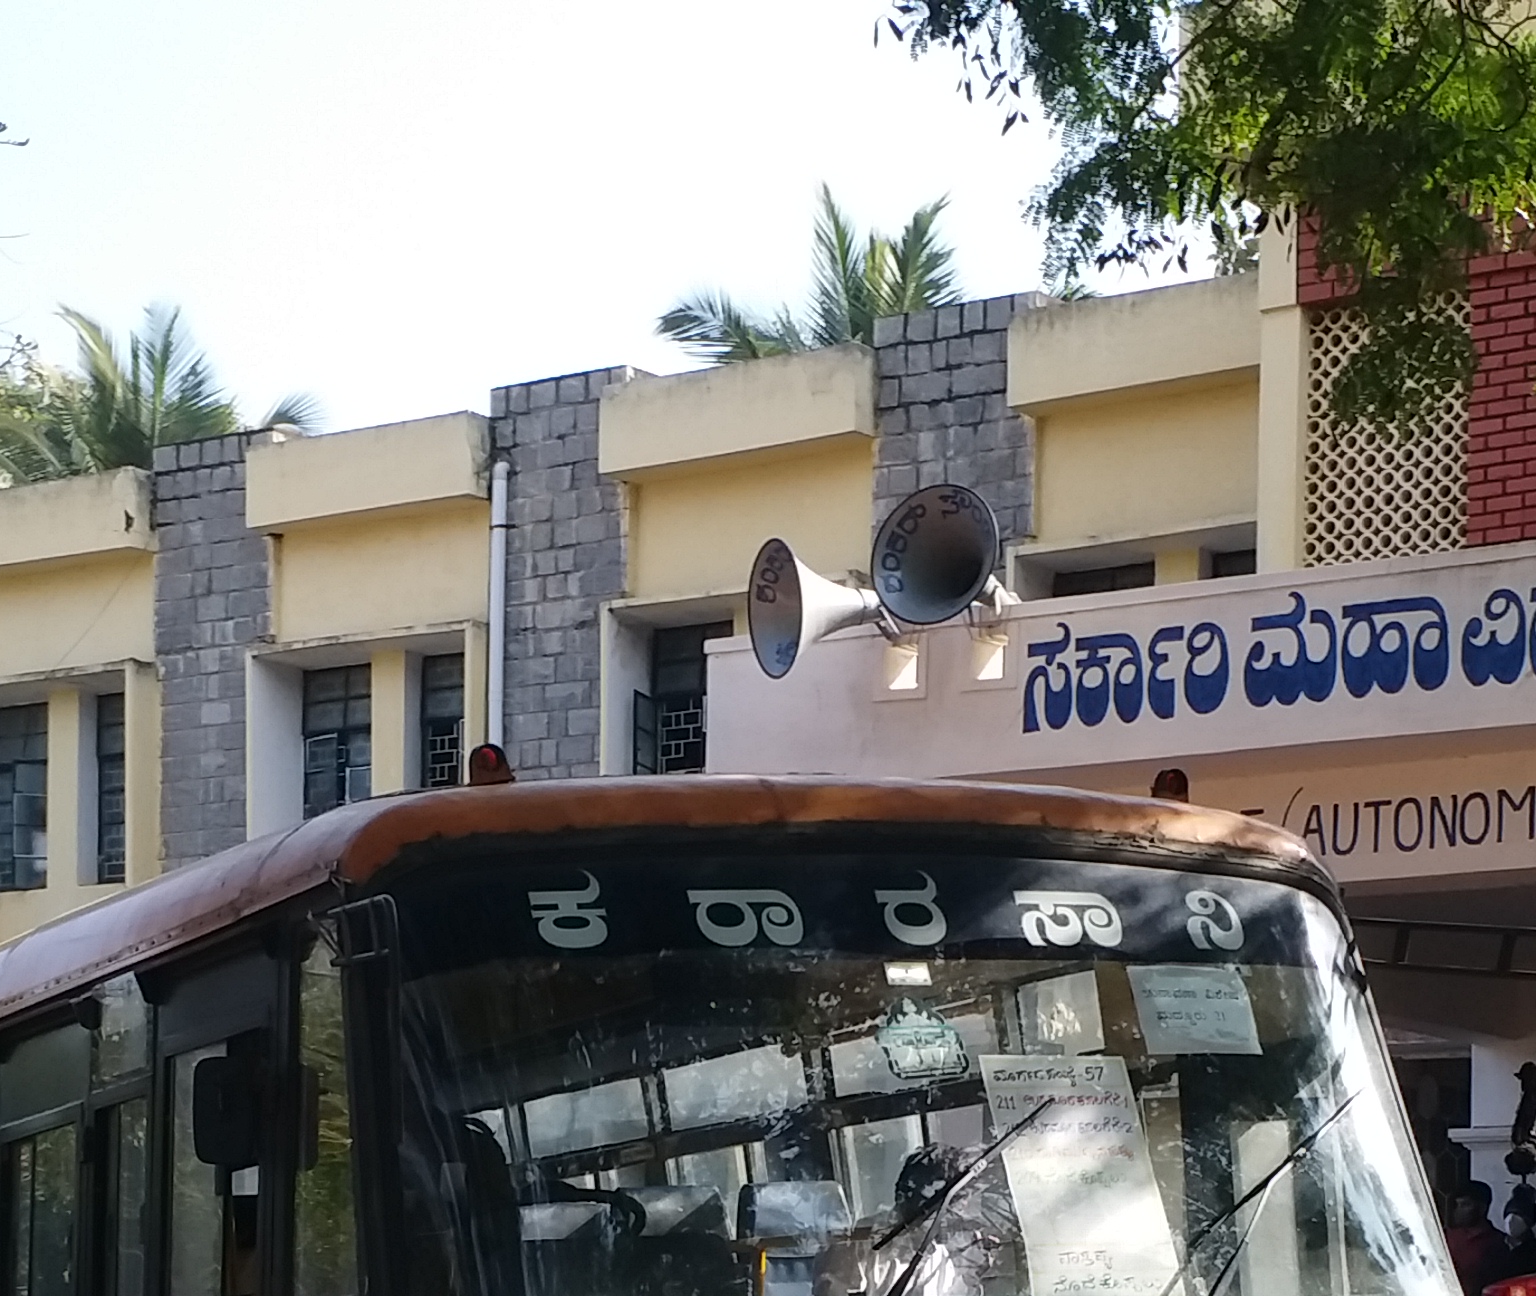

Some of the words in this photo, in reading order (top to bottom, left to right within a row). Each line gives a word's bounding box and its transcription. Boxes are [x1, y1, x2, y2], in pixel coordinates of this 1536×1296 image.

[1022, 621, 1231, 734] ಸರ್ಕಾರಿ
[527, 868, 609, 949] ಕ
[686, 888, 805, 948] ರಾ
[874, 869, 948, 946] ರ
[1013, 889, 1124, 948] ಸಾ
[1185, 889, 1246, 951] ನಿ
